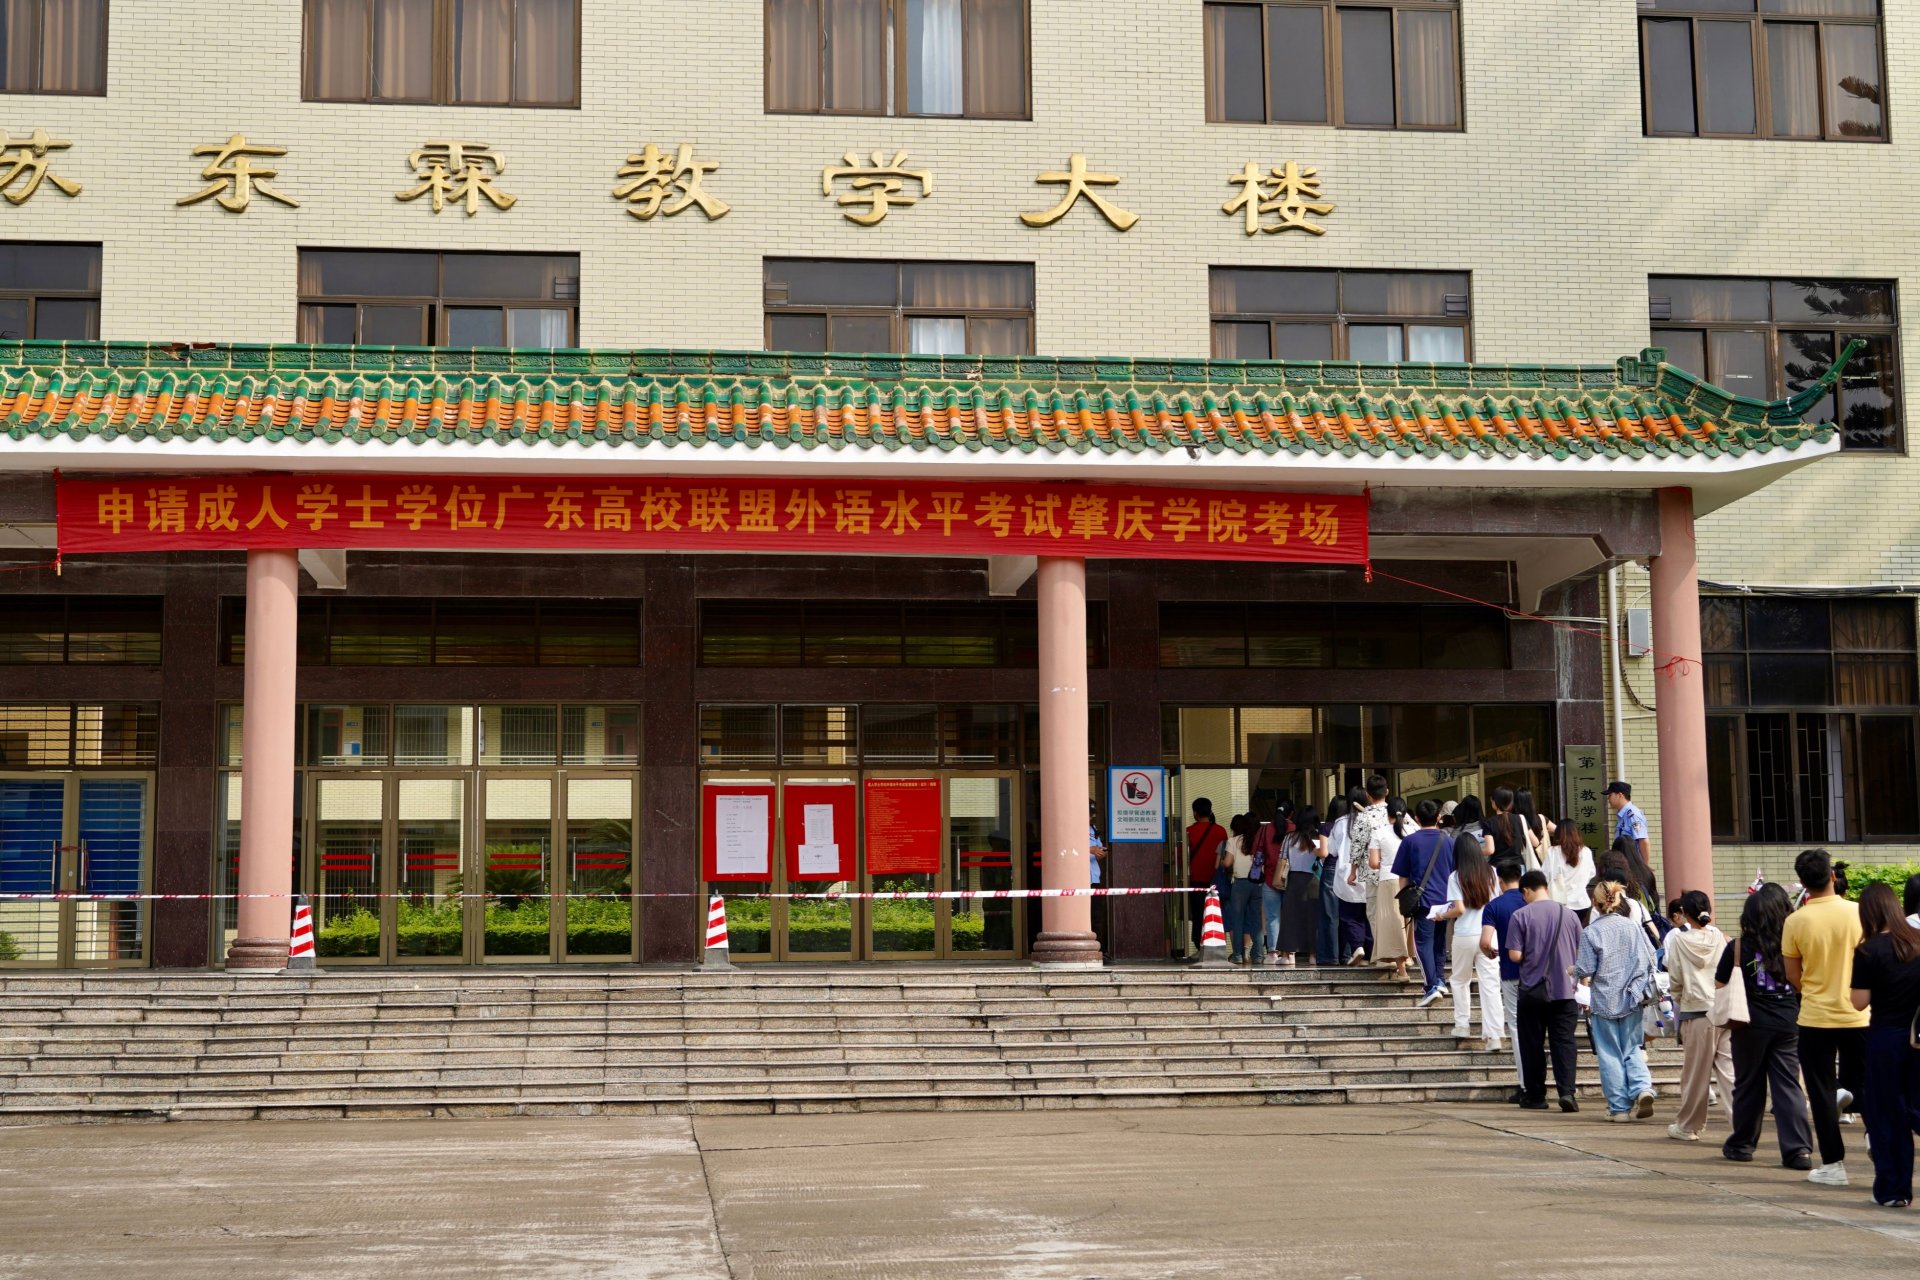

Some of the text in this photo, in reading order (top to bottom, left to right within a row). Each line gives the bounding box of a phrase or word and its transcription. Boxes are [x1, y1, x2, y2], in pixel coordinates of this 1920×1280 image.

[0, 128, 1335, 237] 苏东霖教学大楼
[98, 483, 1339, 546] 申请成人学士学位广东高校联盟外语水平考试肇庆学院考场
